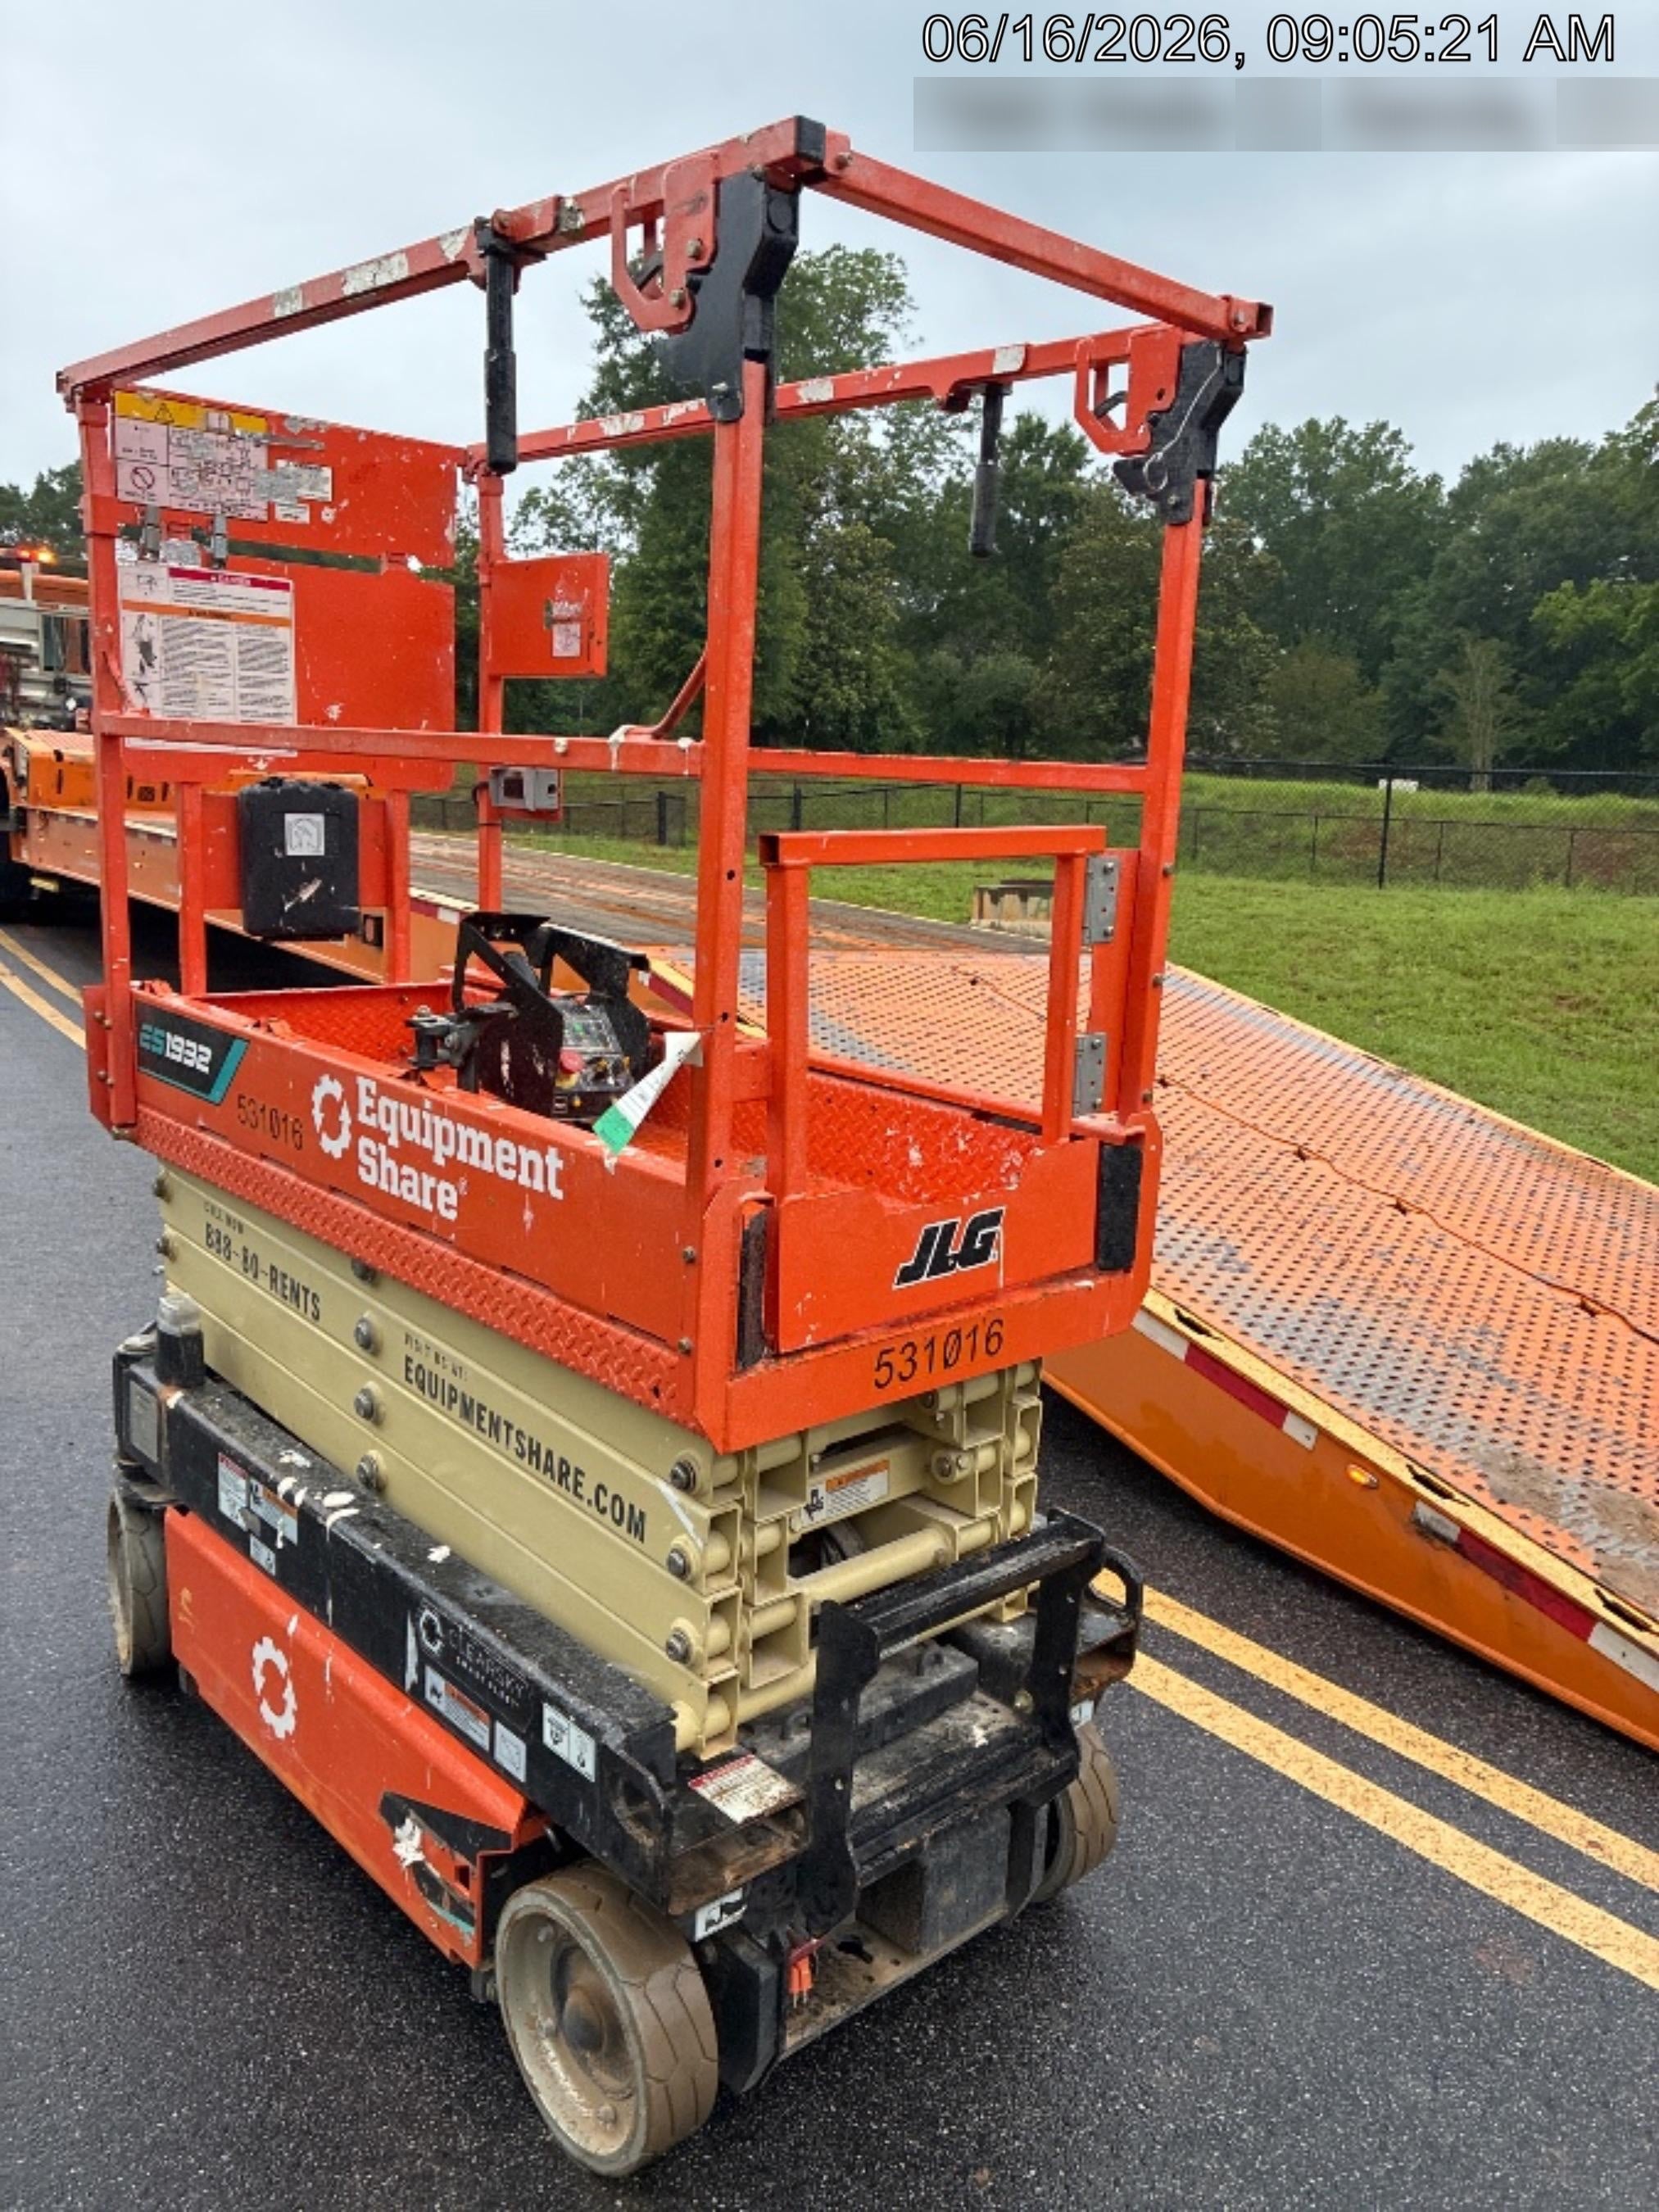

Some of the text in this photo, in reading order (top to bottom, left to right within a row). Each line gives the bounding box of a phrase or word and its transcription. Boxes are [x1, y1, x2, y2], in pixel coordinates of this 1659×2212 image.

[237, 1095, 303, 1151] 531016
[356, 1076, 564, 1200] Equipment
[892, 1205, 1007, 1291] JLG
[873, 1318, 1004, 1389] 531016
[404, 1353, 647, 1544] EQUIPMENTSHARE.COM
